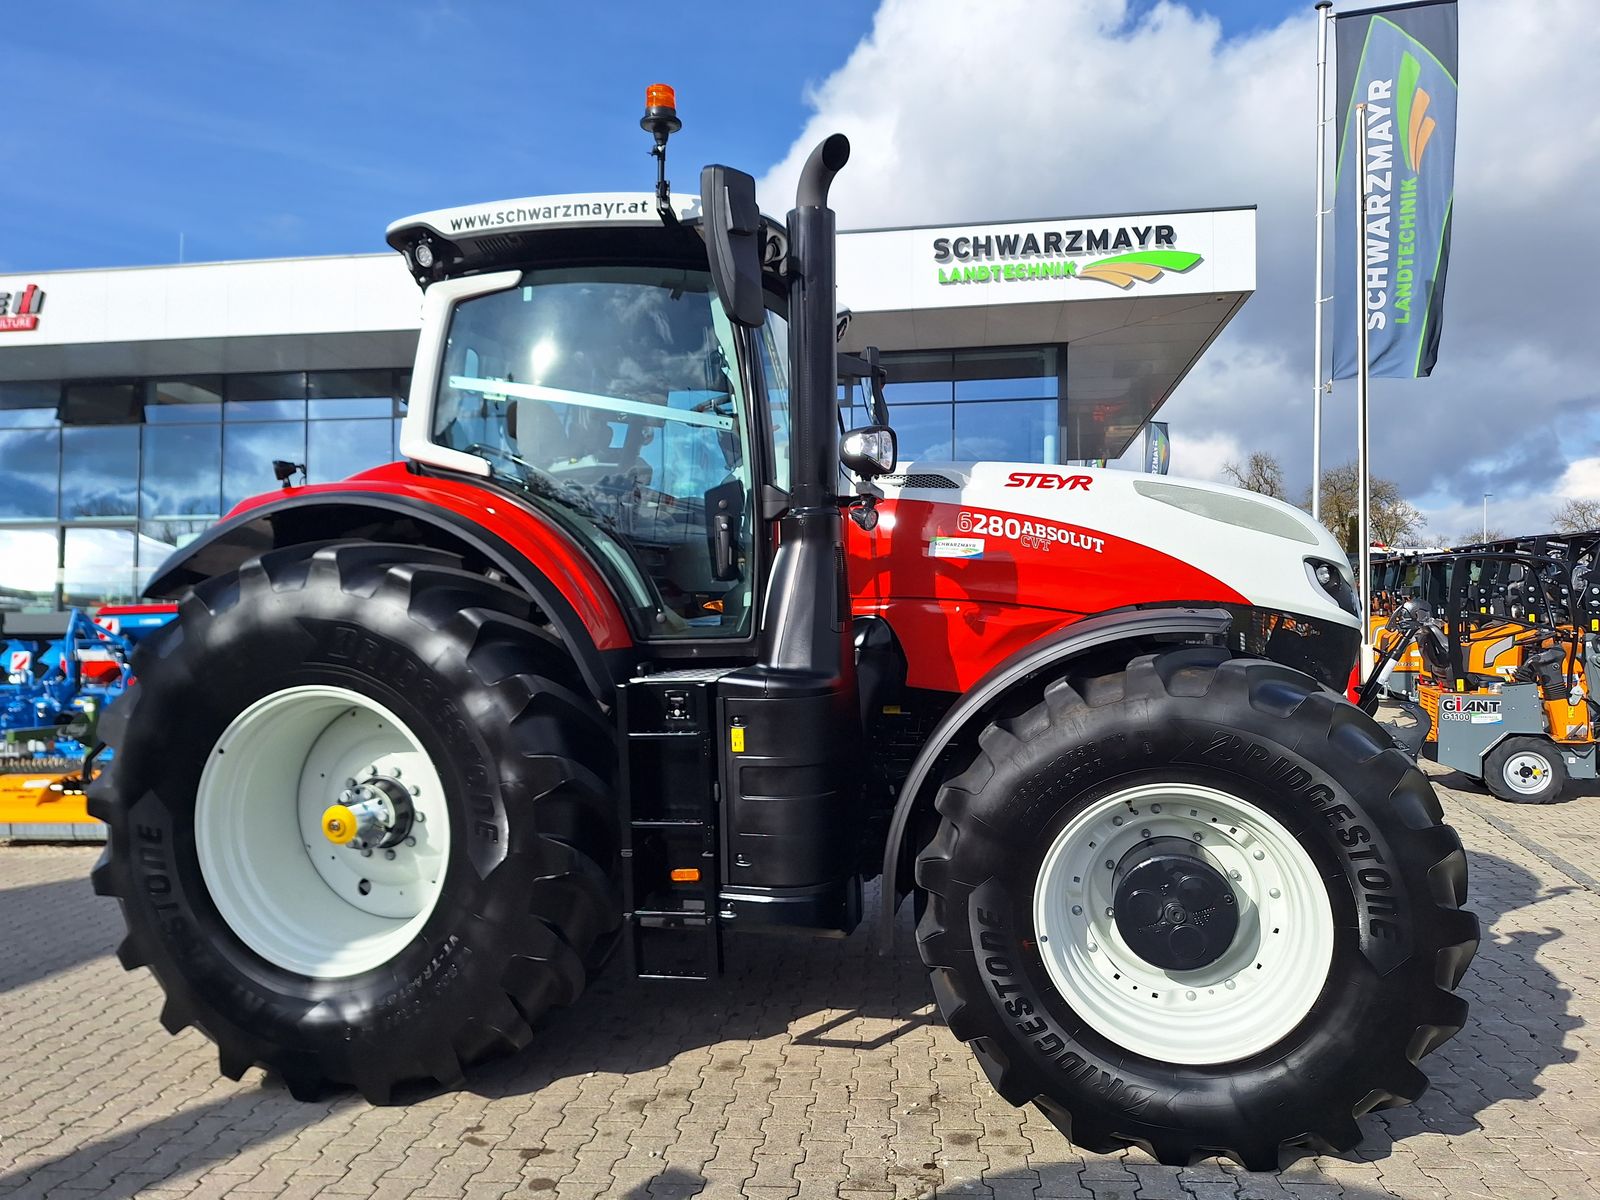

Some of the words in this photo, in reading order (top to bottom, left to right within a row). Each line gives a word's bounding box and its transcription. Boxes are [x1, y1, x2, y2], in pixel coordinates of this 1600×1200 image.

[450, 200, 649, 231] www.schwarzmayr.at
[1366, 78, 1393, 331] SCHWARZMAYR
[934, 225, 1176, 261] SCHWARZMAYR
[1394, 176, 1418, 324] LANDTECHNIK
[938, 260, 1078, 284] LANDTECHNIK
[1004, 472, 1093, 491] STEYR
[956, 511, 1021, 539] 6280
[1021, 521, 1105, 553] ABSOLUT
[1020, 535, 1051, 551] CVT
[1442, 713, 1471, 721] G1100
[1201, 729, 1400, 943] BRIDGESTONE
[977, 906, 1158, 1116] BRIDGESTONE
